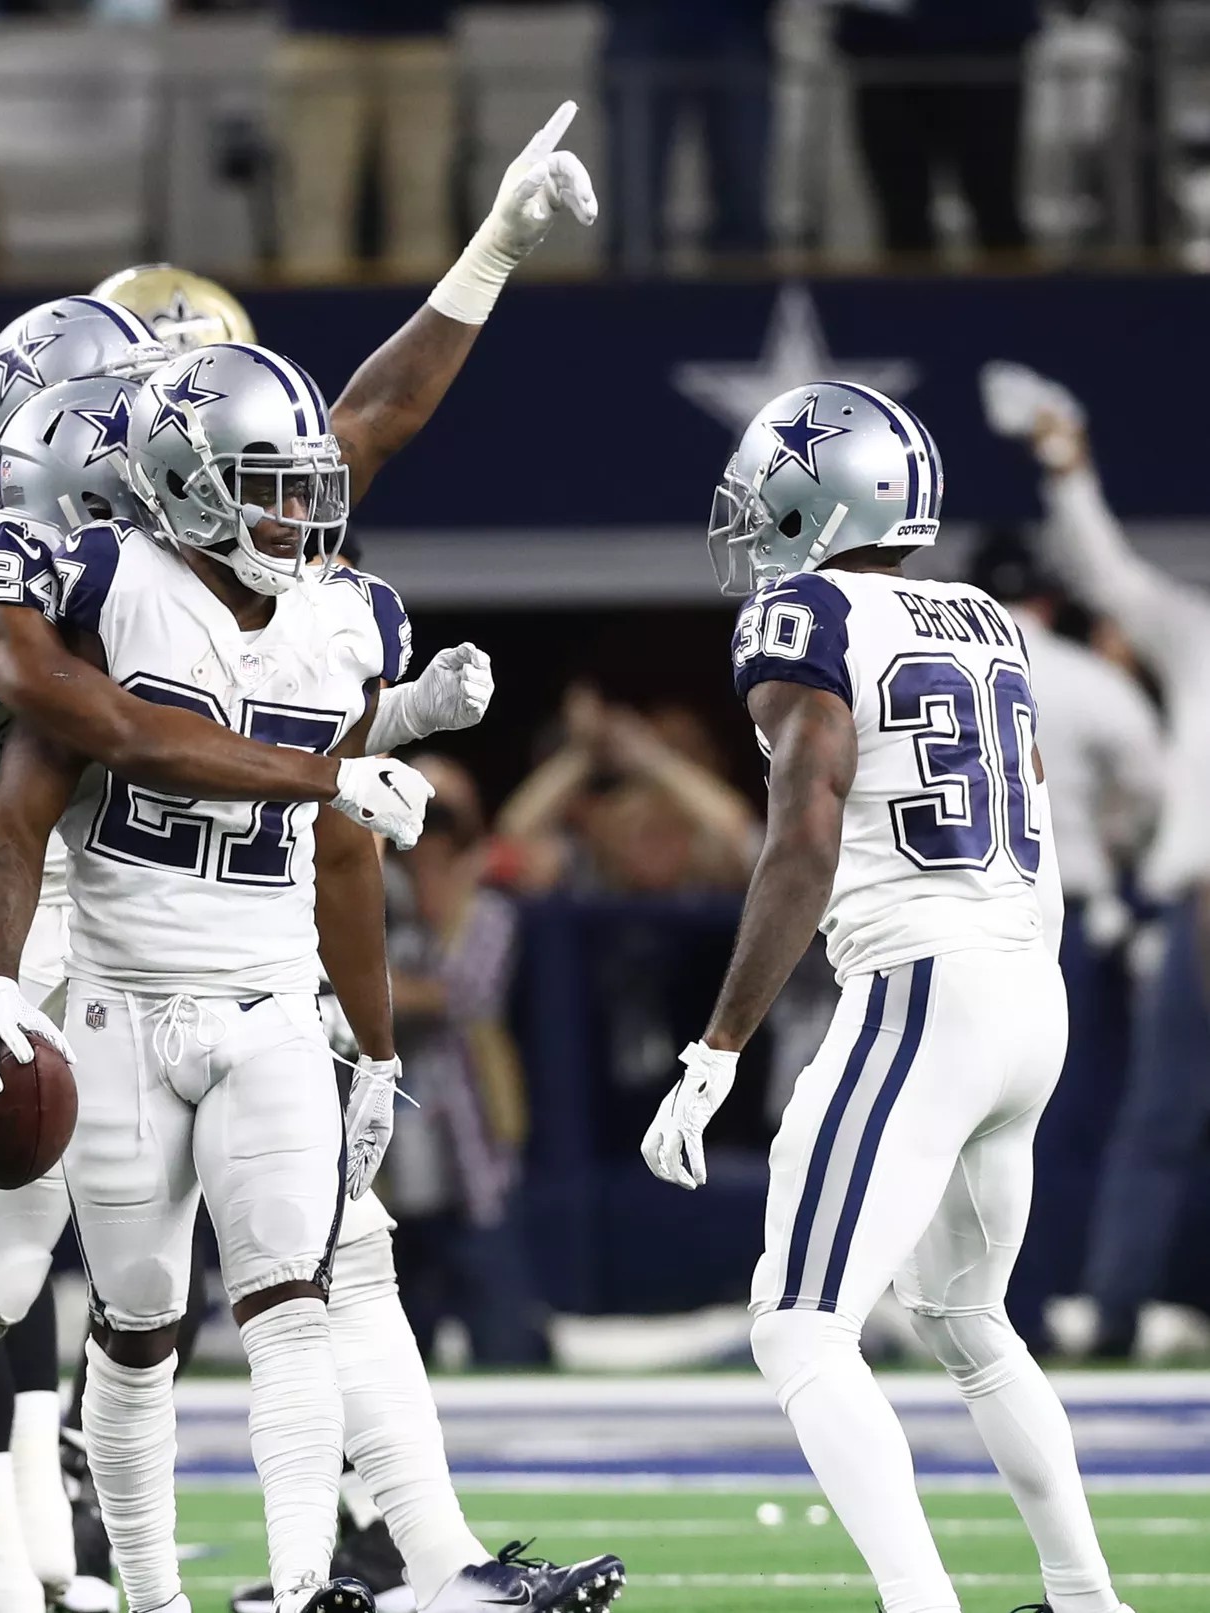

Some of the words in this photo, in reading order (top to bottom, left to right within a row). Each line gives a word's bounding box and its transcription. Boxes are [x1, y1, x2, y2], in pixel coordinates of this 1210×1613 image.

[735, 602, 815, 667] 30
[892, 590, 1014, 647] BROWN
[84, 671, 348, 888] 27
[876, 652, 1041, 886] 30
